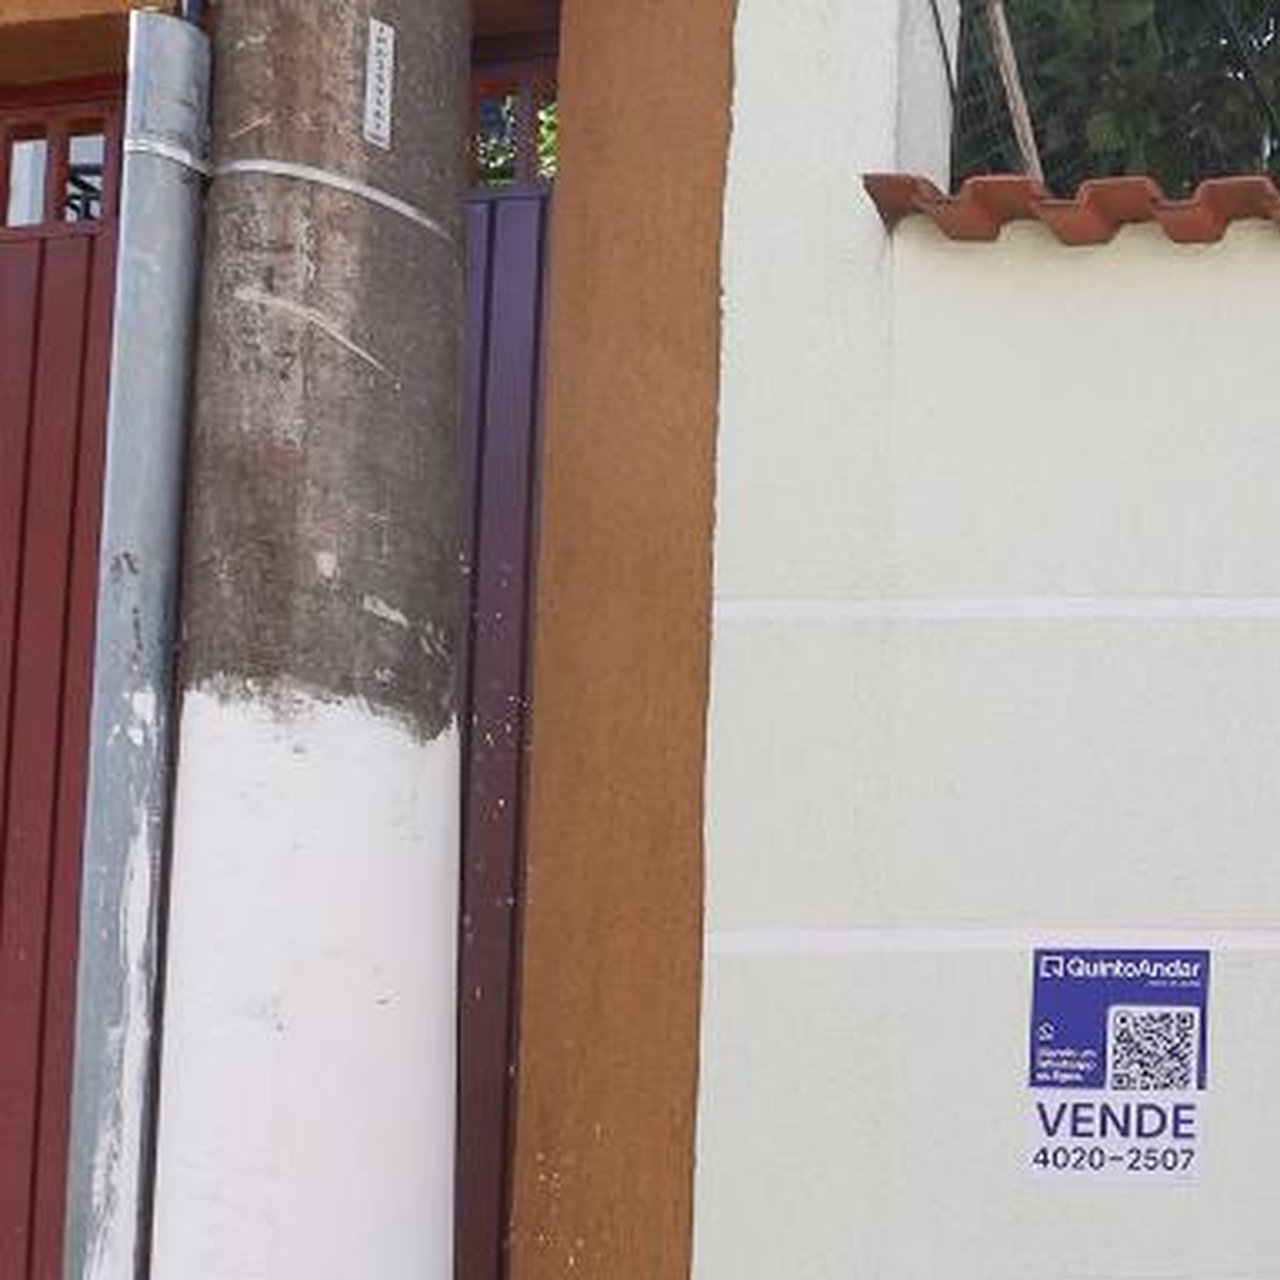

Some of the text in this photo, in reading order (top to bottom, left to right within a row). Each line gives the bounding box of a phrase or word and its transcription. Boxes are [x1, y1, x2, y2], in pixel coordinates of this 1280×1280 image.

[1066, 957, 1201, 979] QuintoAndar
[1036, 1102, 1196, 1140] VENDE
[1032, 1147, 1196, 1171] 4020-2507
